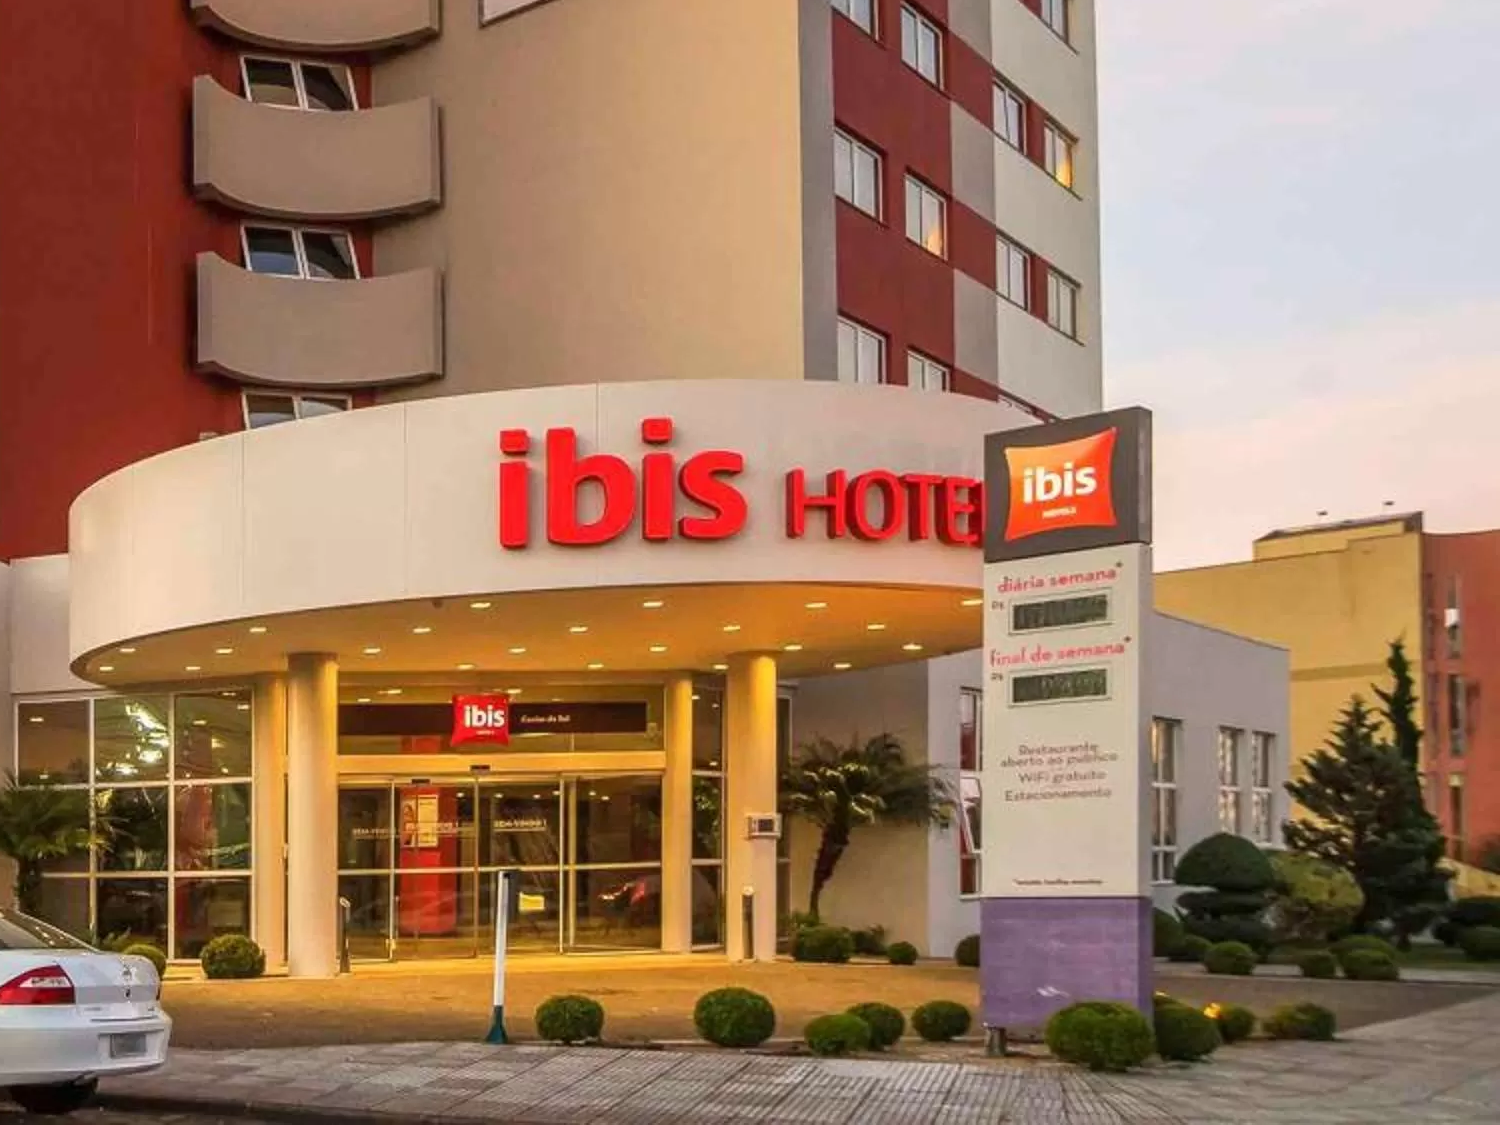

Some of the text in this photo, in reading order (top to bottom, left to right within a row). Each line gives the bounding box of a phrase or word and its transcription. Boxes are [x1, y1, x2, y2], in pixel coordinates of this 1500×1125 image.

[499, 417, 985, 549] ibis HOTE
[1023, 461, 1097, 505] ibis
[1030, 644, 1053, 665] de
[464, 704, 505, 728] ibis
